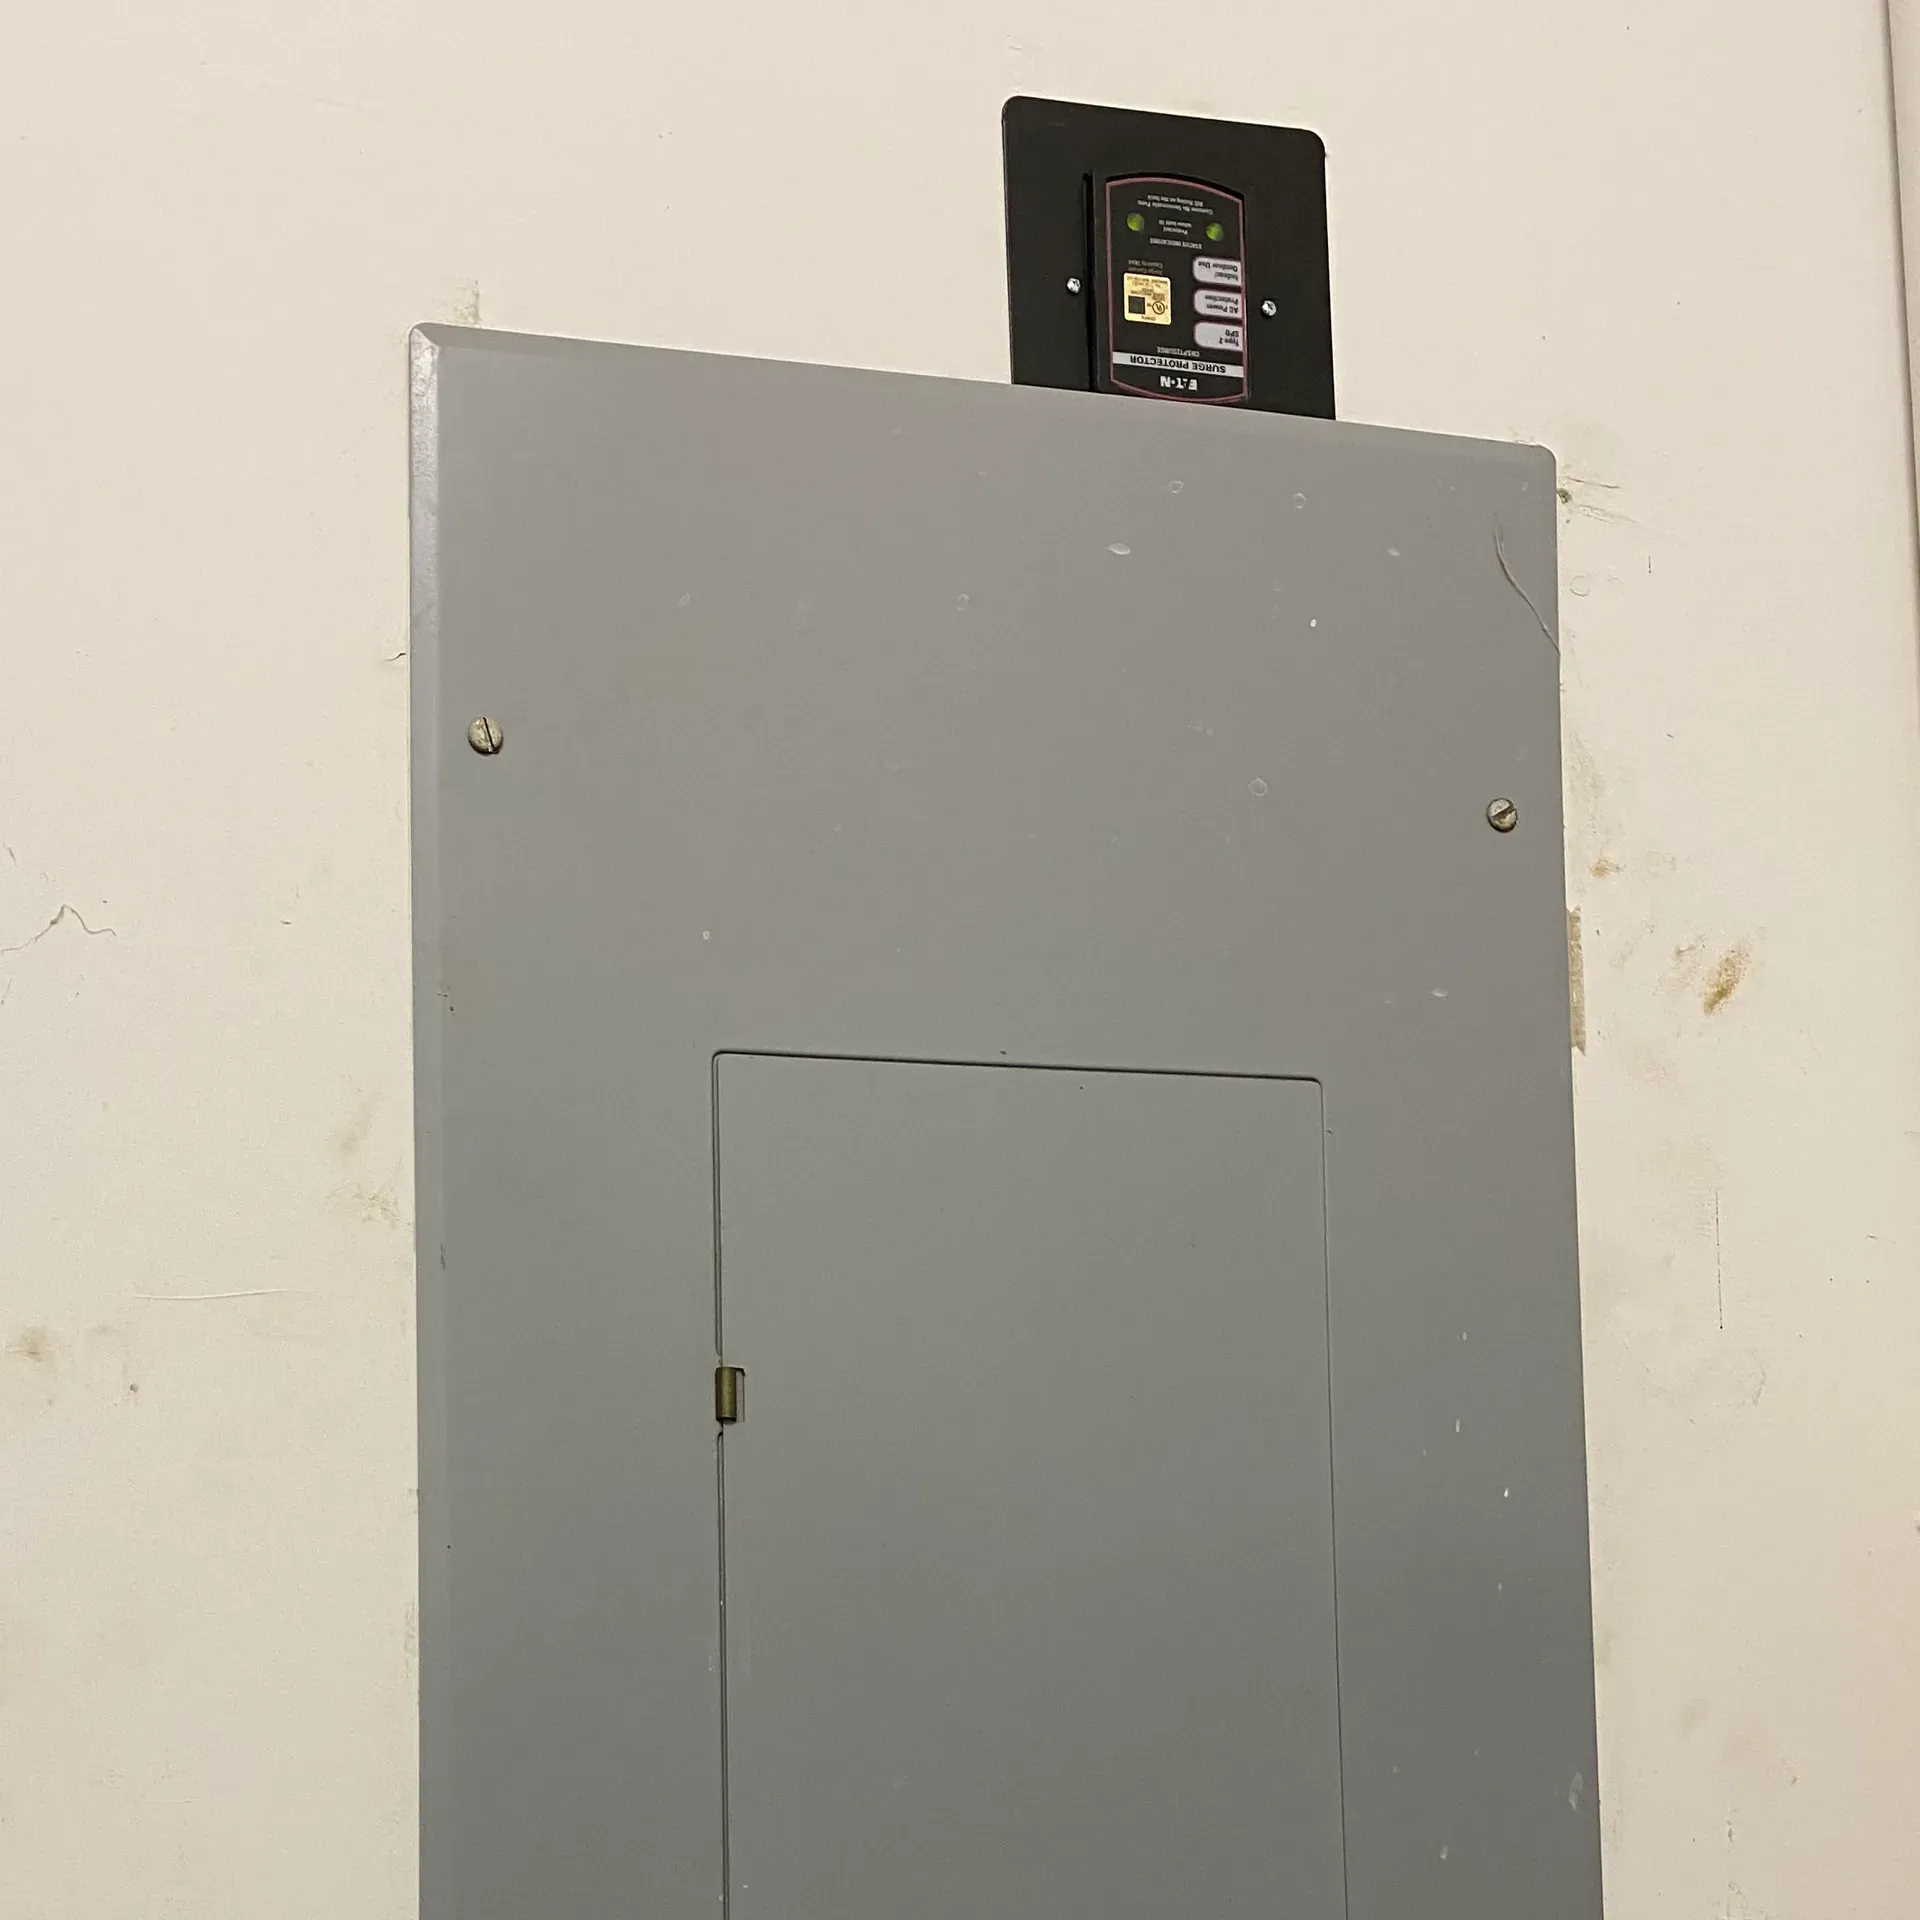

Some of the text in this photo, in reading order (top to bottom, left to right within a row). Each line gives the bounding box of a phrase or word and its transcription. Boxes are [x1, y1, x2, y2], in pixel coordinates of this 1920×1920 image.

[1212, 264, 1238, 272] Outdoor
[1205, 295, 1238, 305] Protection
[1207, 304, 1238, 314] AC Power
[1225, 338, 1239, 347] Type
[1130, 356, 1226, 373] SURGE PROTECTOR
